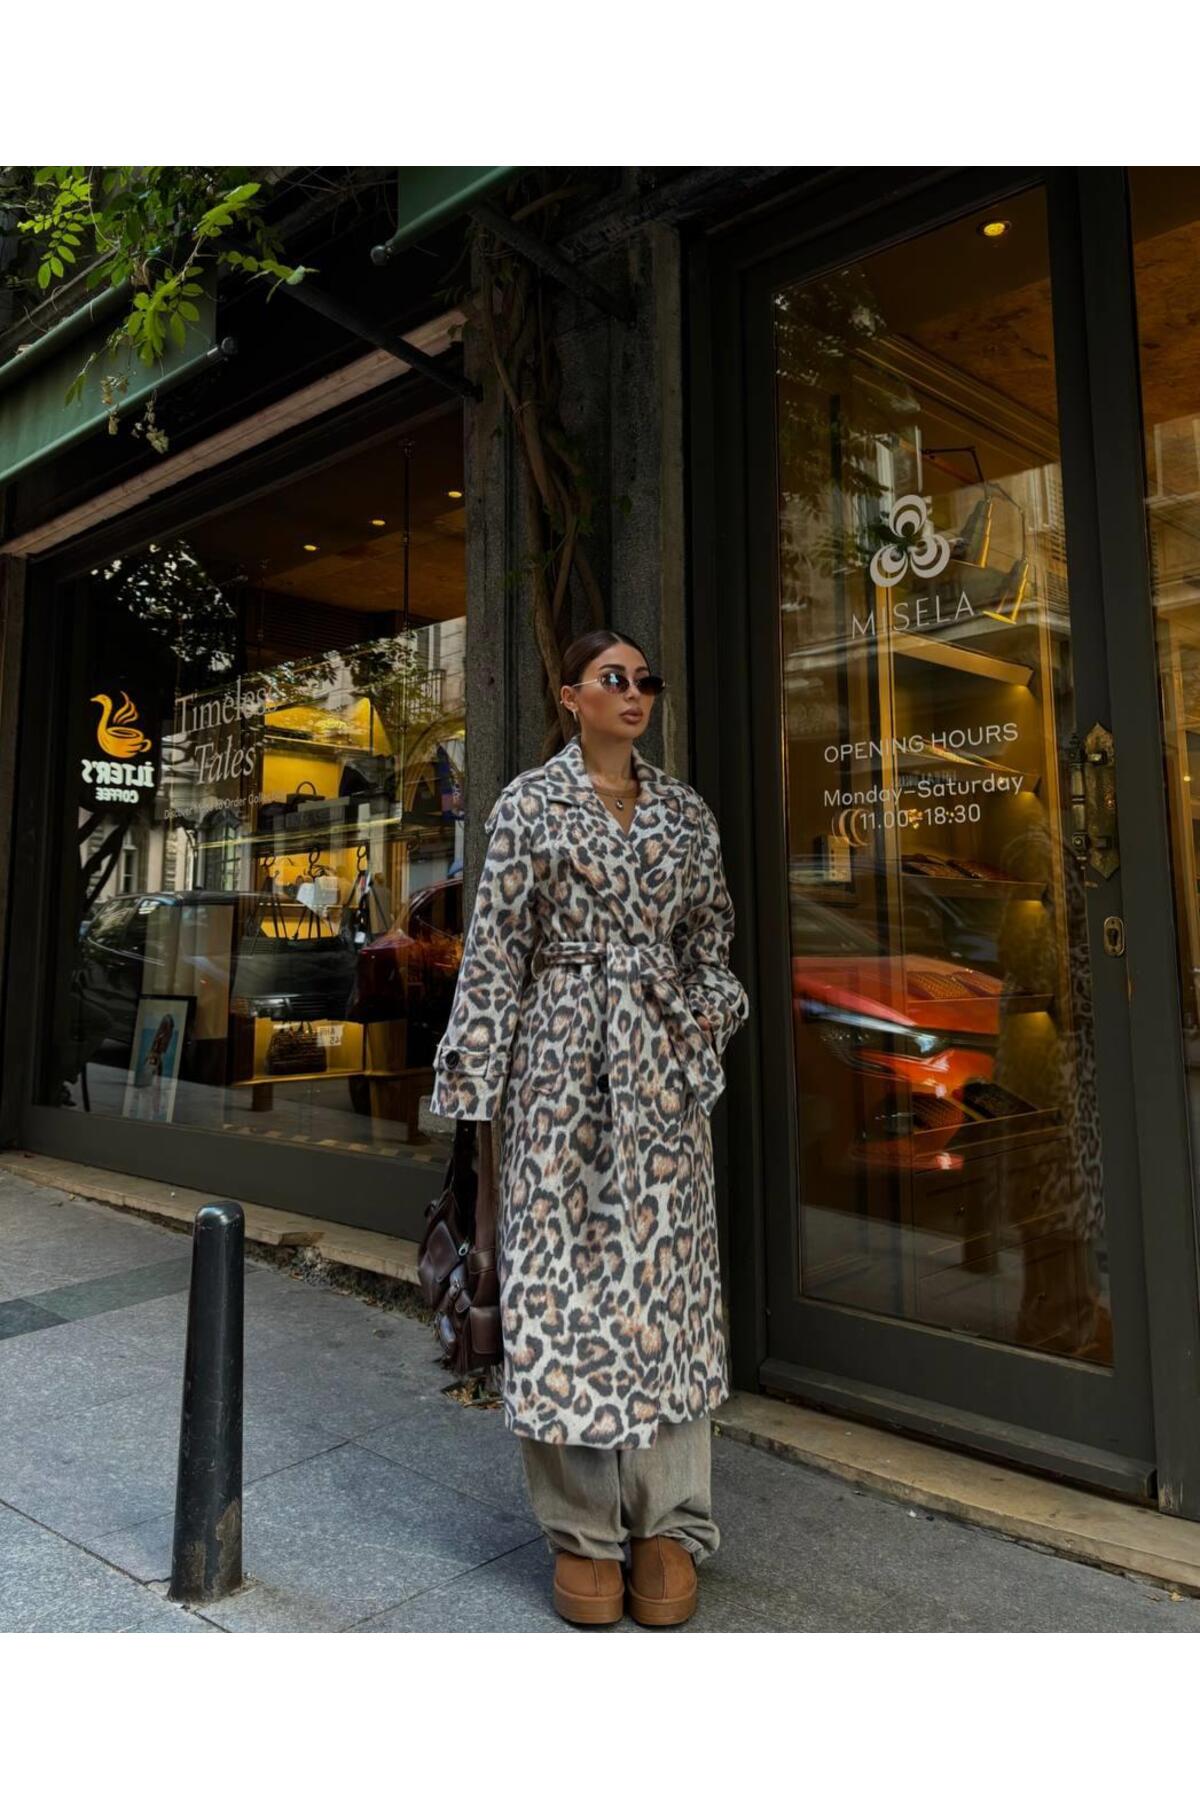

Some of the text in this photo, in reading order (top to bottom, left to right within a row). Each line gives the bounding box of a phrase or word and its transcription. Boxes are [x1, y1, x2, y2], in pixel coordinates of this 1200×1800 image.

[851, 590, 975, 641] MISELA
[194, 734, 257, 786] Tales
[824, 722, 1019, 763] OPENING HOURS
[224, 795, 247, 809] Order
